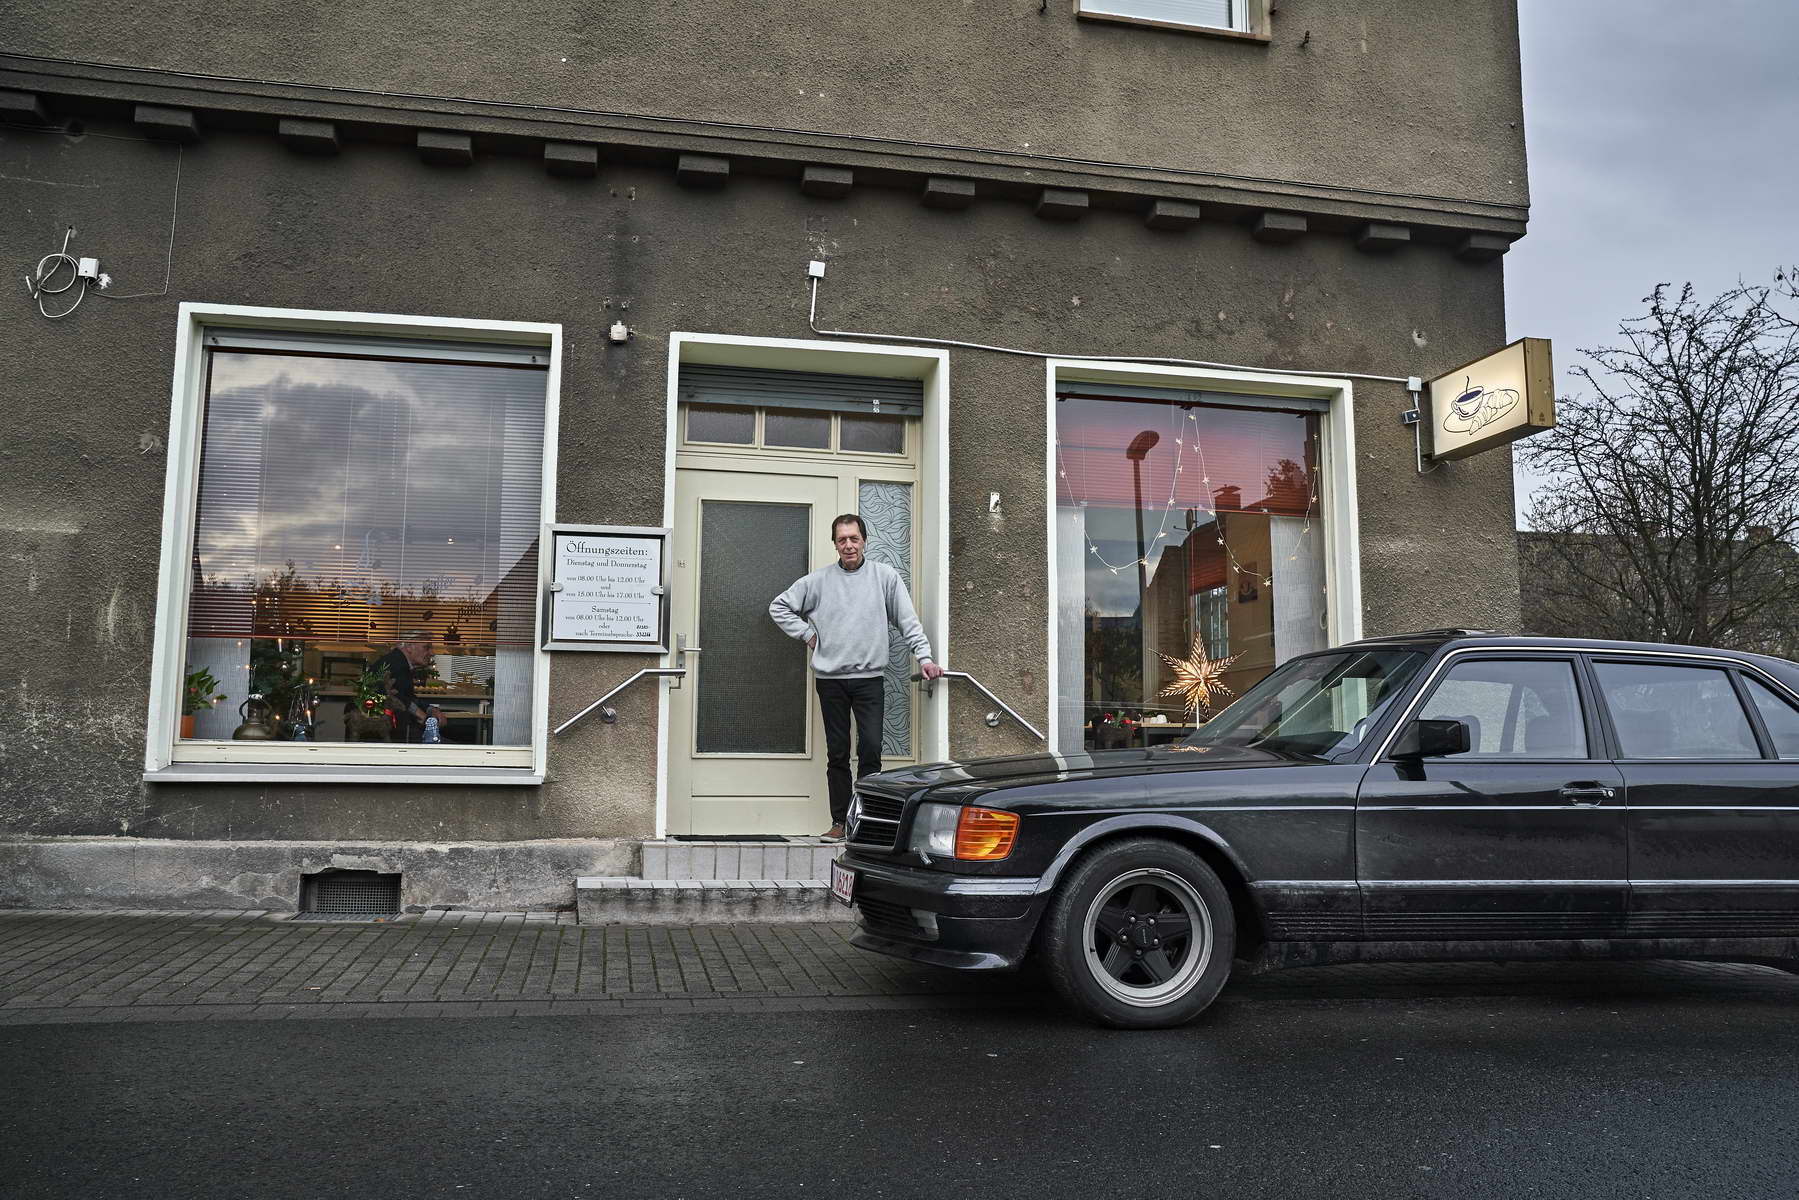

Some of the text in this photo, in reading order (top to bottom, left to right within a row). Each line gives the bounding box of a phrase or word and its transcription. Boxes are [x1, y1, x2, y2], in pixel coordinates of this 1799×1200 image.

[566, 540, 648, 556] Öffnungszeiten:
[567, 559, 594, 567] Dienstag
[611, 560, 647, 569] Donnerstag
[591, 606, 619, 614] Samstag
